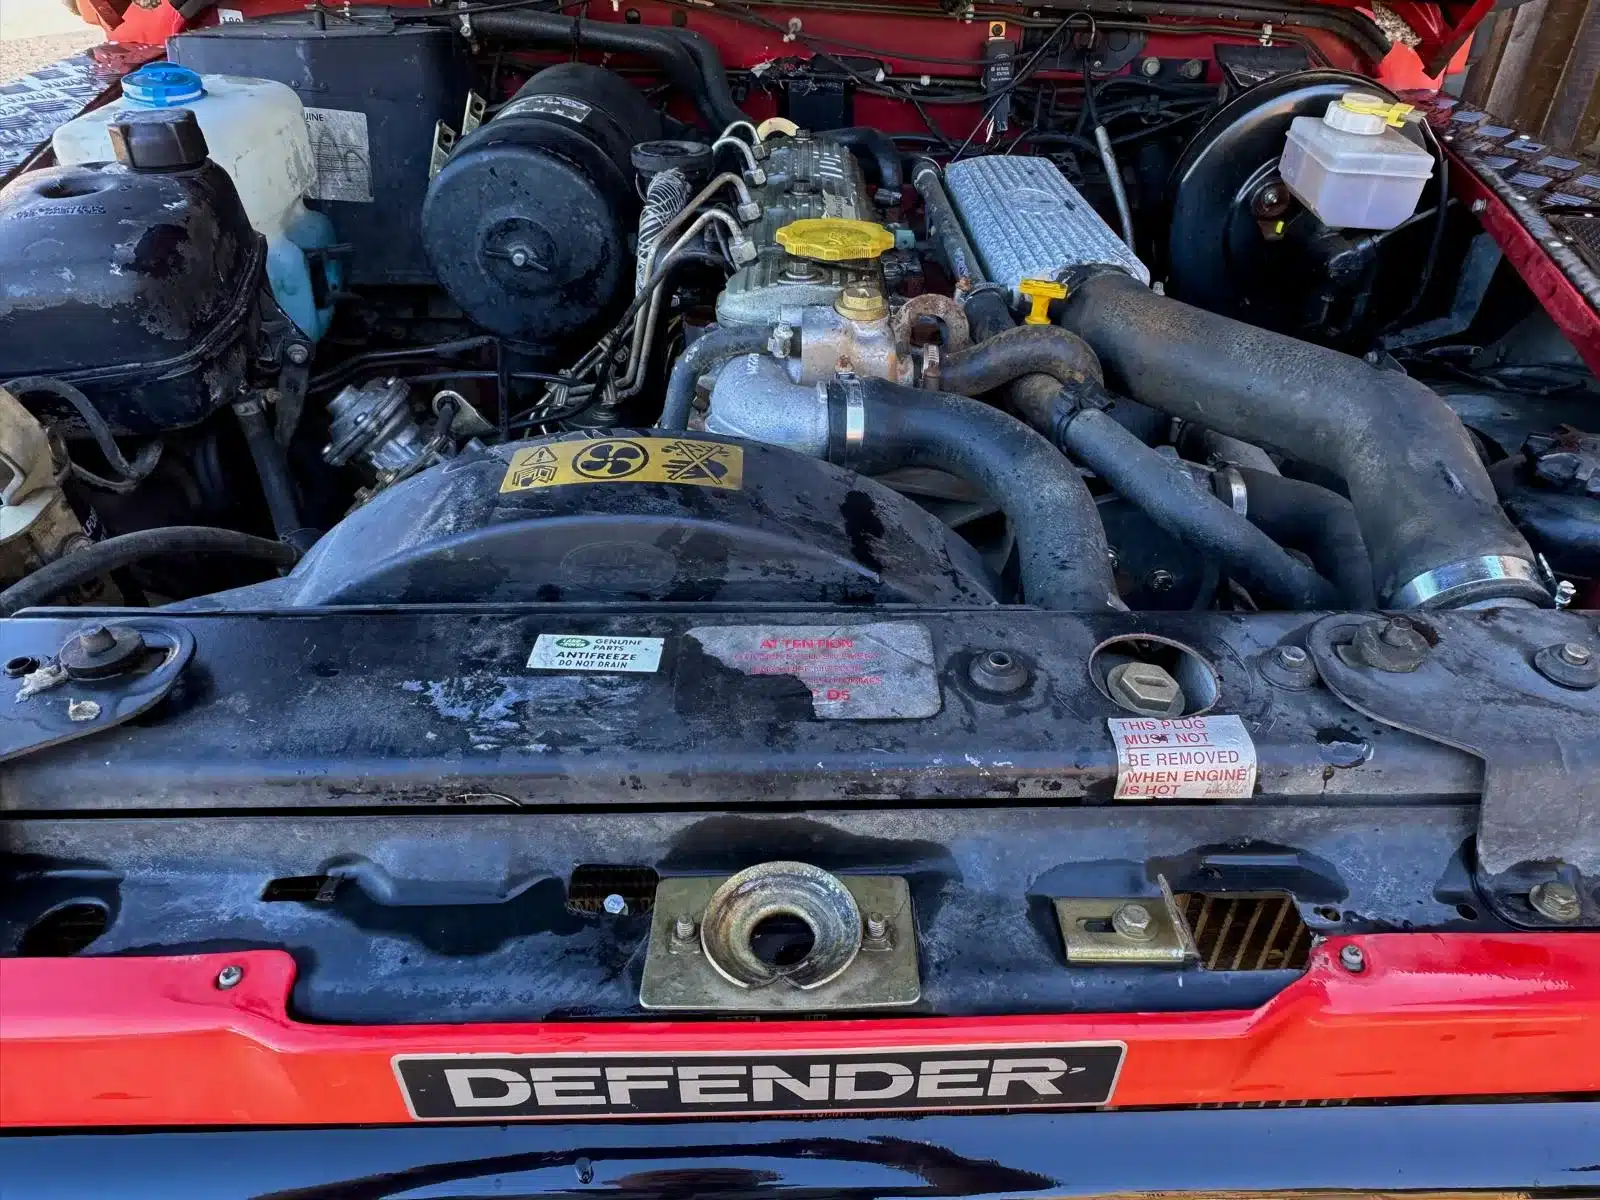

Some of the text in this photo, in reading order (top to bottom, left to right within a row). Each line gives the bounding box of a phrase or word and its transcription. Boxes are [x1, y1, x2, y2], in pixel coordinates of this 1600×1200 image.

[760, 638, 853, 649] ATTENTION
[556, 651, 637, 660] ANTIFREEZE
[1120, 719, 1206, 731] THIS PLUG
[1124, 732, 1209, 745] MUST NOT
[1129, 750, 1239, 766] BE REMOVED
[1127, 768, 1247, 783] WHEN ENGINE
[1123, 784, 1181, 795] IS HOT
[444, 1057, 1069, 1108] DEFENDER
